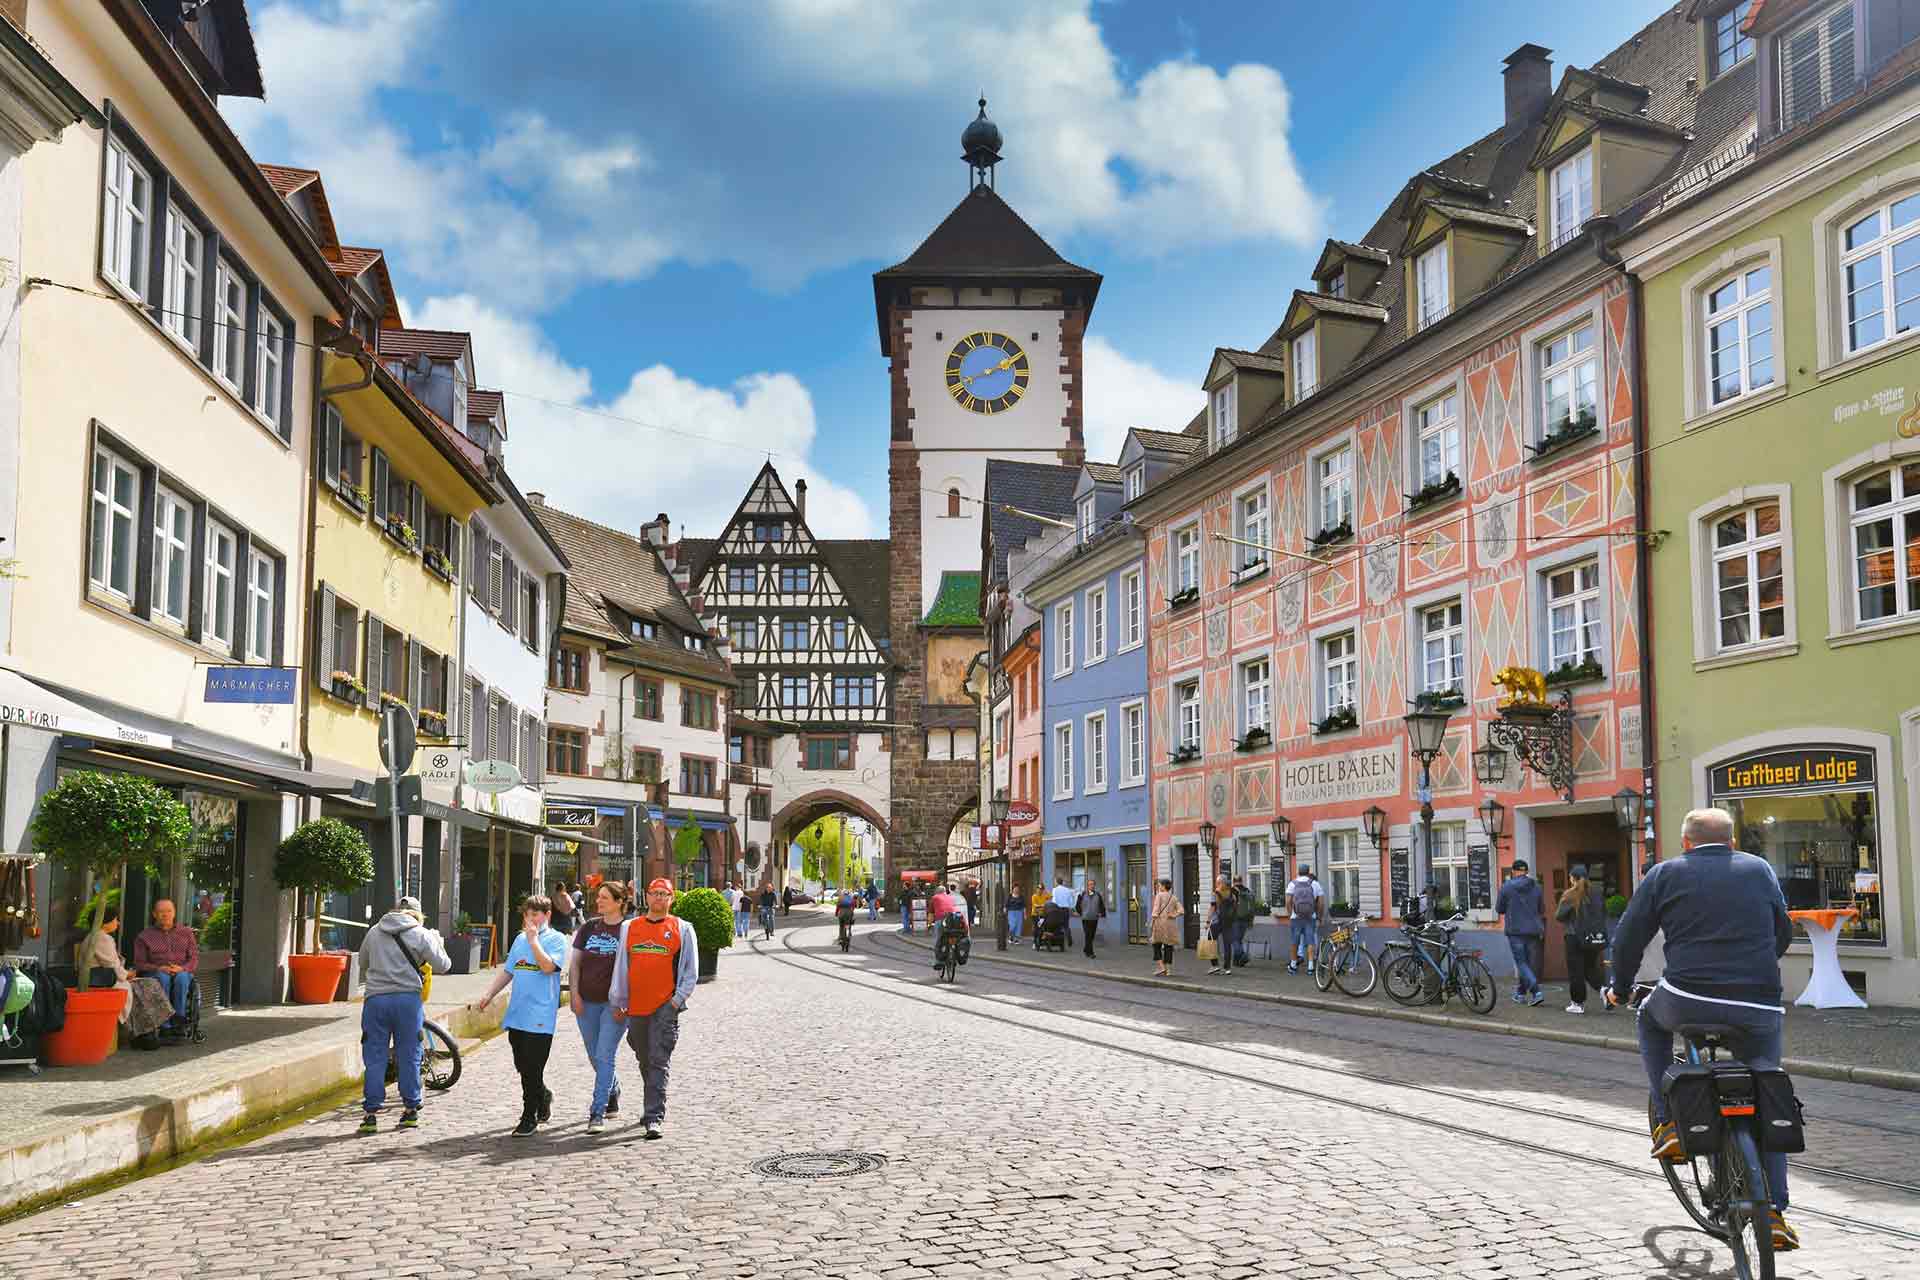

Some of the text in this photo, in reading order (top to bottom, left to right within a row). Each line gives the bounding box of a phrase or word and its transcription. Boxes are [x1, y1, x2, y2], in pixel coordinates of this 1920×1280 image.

[116, 726, 149, 743] Taschen
[1285, 751, 1396, 789] HOTEL BÄREN
[1727, 756, 1857, 788] Craftbeer Lodge
